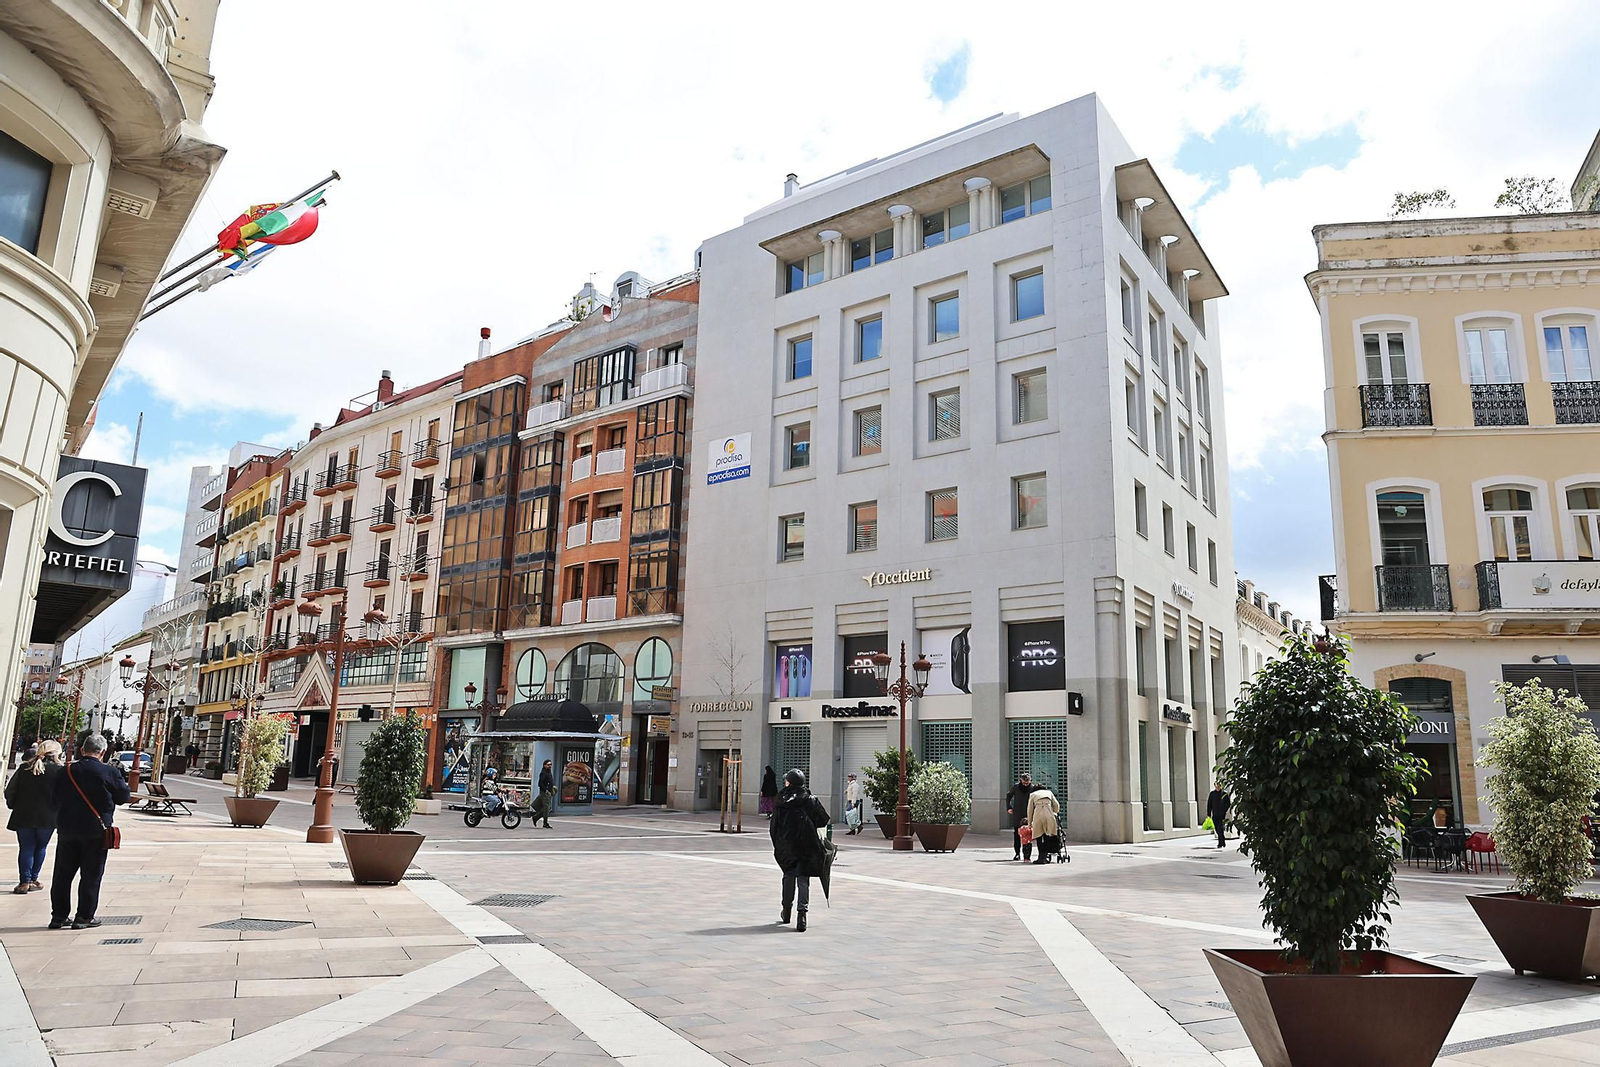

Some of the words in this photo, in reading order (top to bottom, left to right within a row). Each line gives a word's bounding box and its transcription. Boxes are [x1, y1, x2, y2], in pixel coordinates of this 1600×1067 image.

[715, 452, 743, 468] prodisa
[708, 468, 749, 483] eprodisa.com
[48, 470, 123, 547] C
[43, 549, 129, 574] RTEFIEL
[877, 567, 931, 585] Occident
[1021, 648, 1057, 667] PRO
[854, 658, 876, 675] PR
[566, 751, 590, 763] GOIKO
